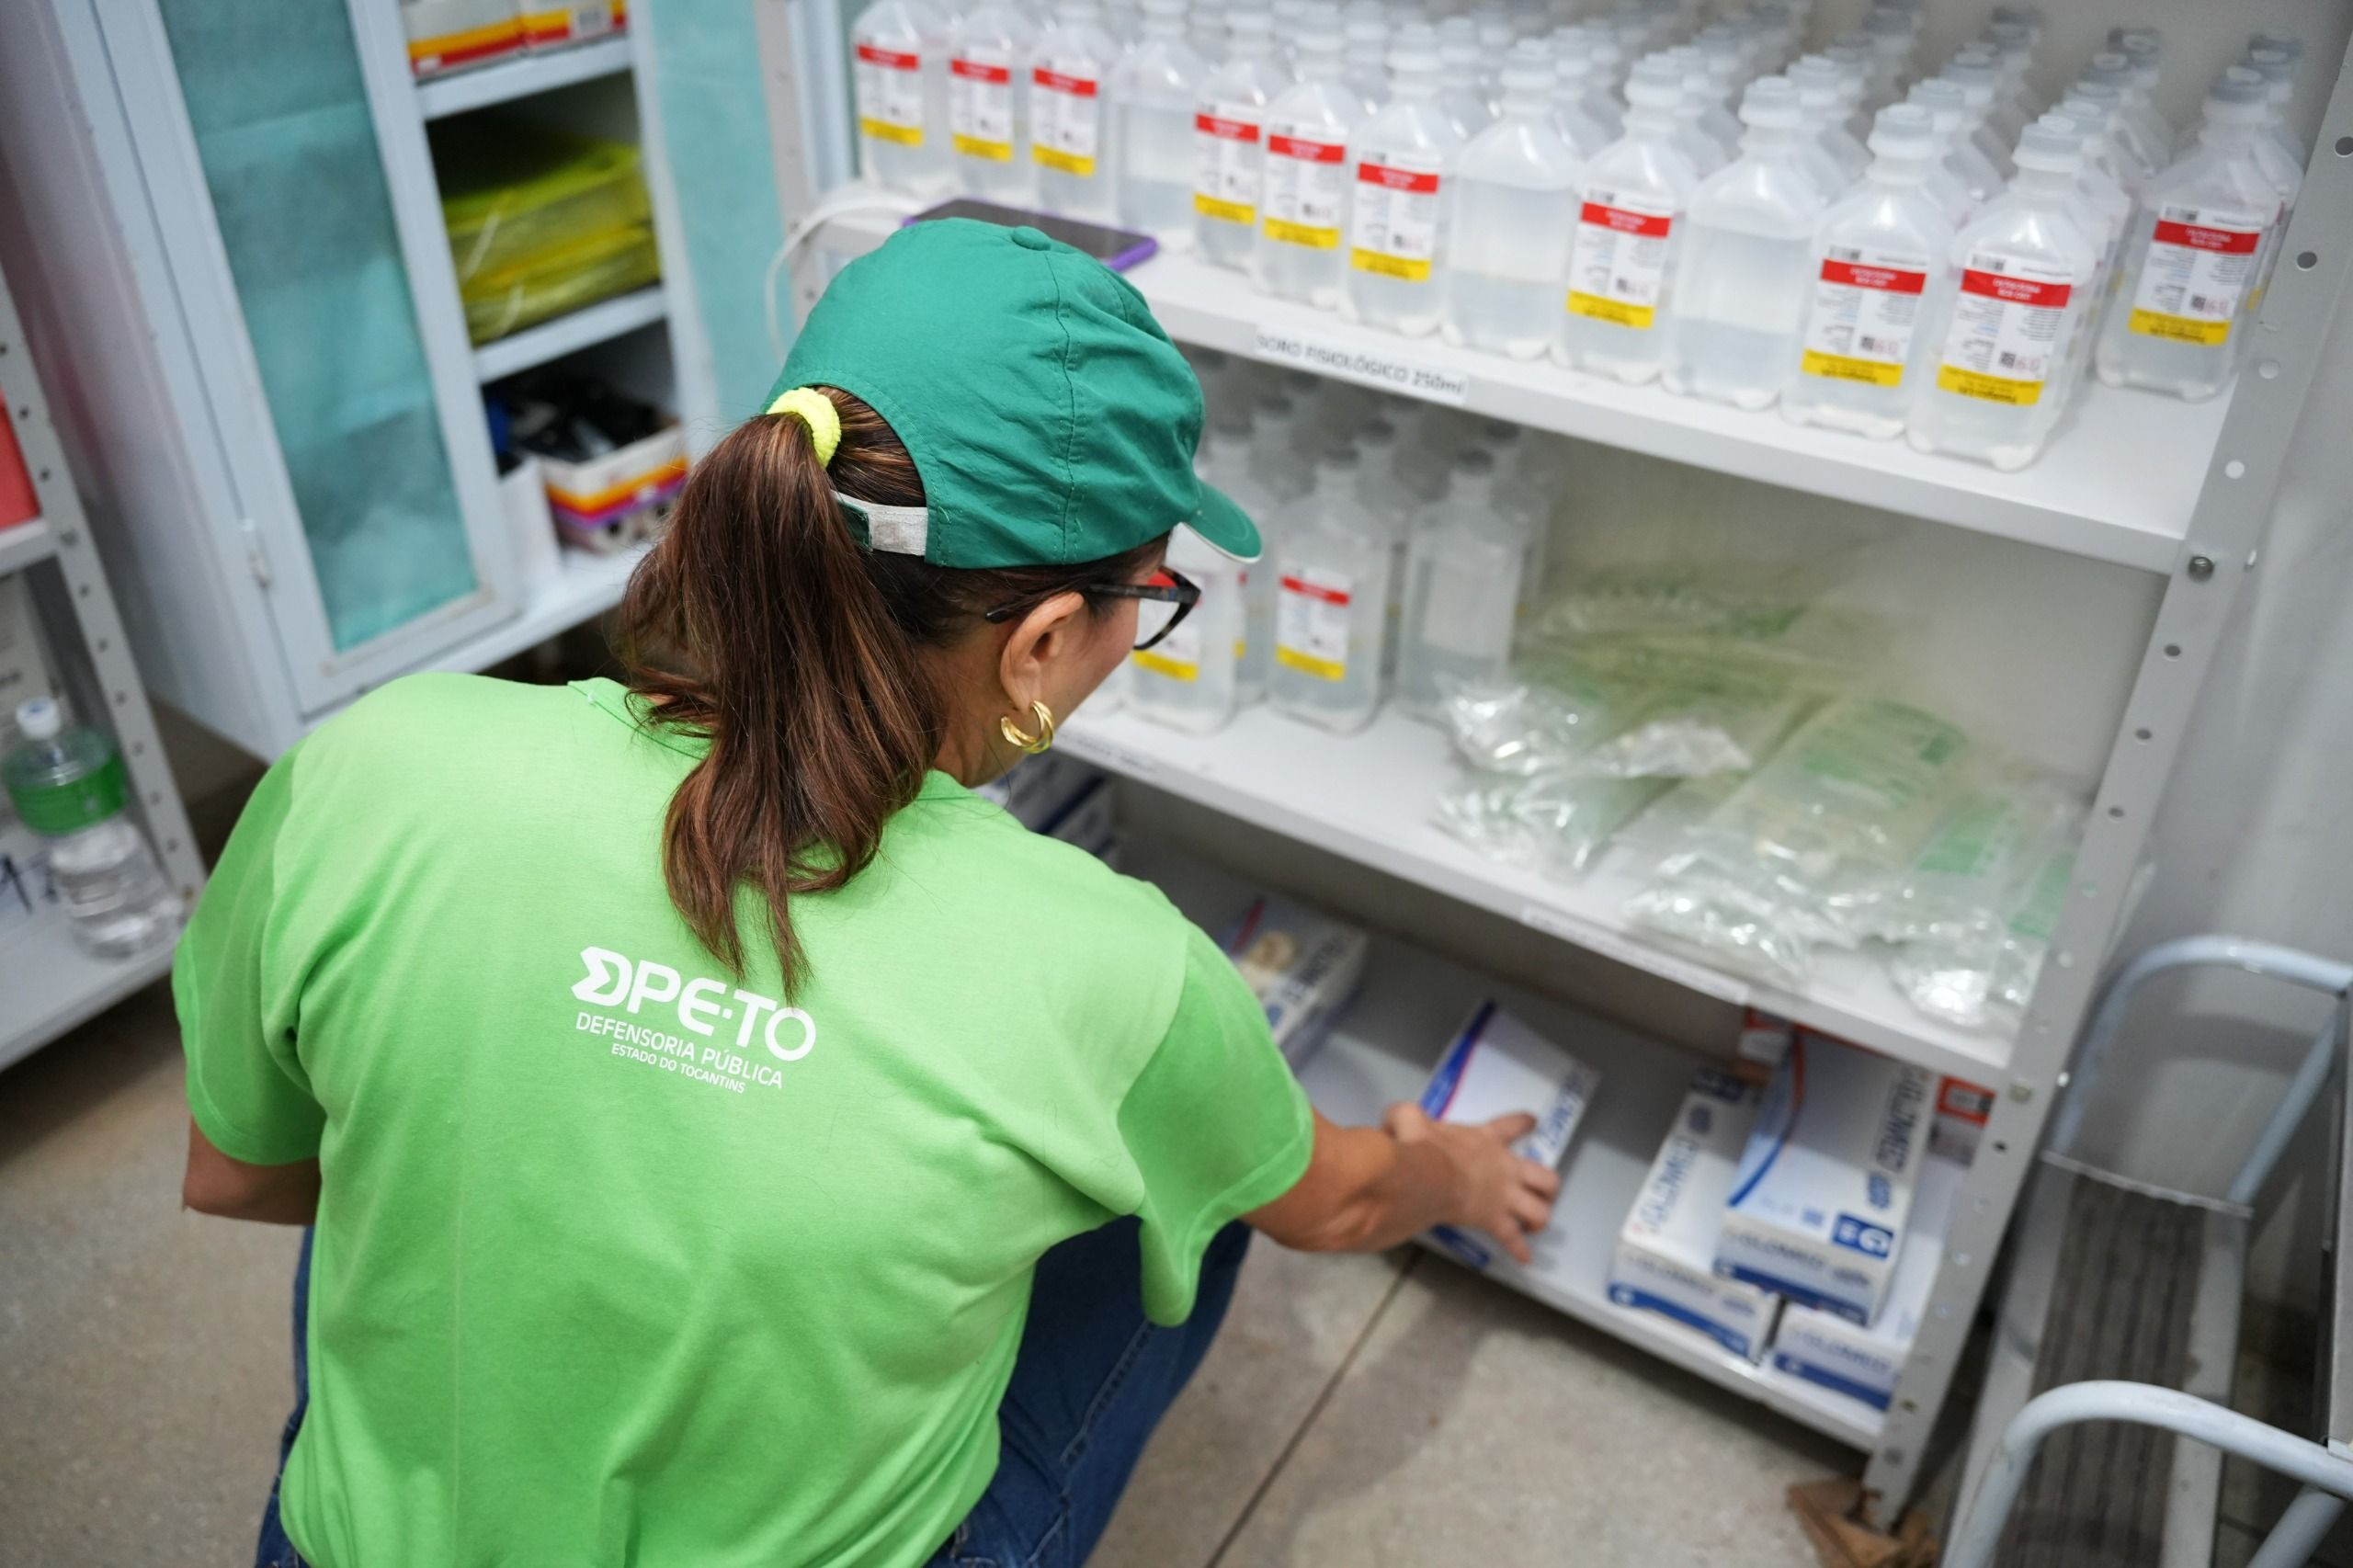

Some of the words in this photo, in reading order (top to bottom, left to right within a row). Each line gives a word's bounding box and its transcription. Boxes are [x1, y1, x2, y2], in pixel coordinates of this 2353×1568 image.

[575, 1012, 695, 1061] DEFENSORIA
[700, 1049, 782, 1088] PÚBLICA
[611, 1043, 657, 1065] ESTADO
[659, 1056, 677, 1072] DO
[680, 1062, 746, 1094] TOCANTINS
